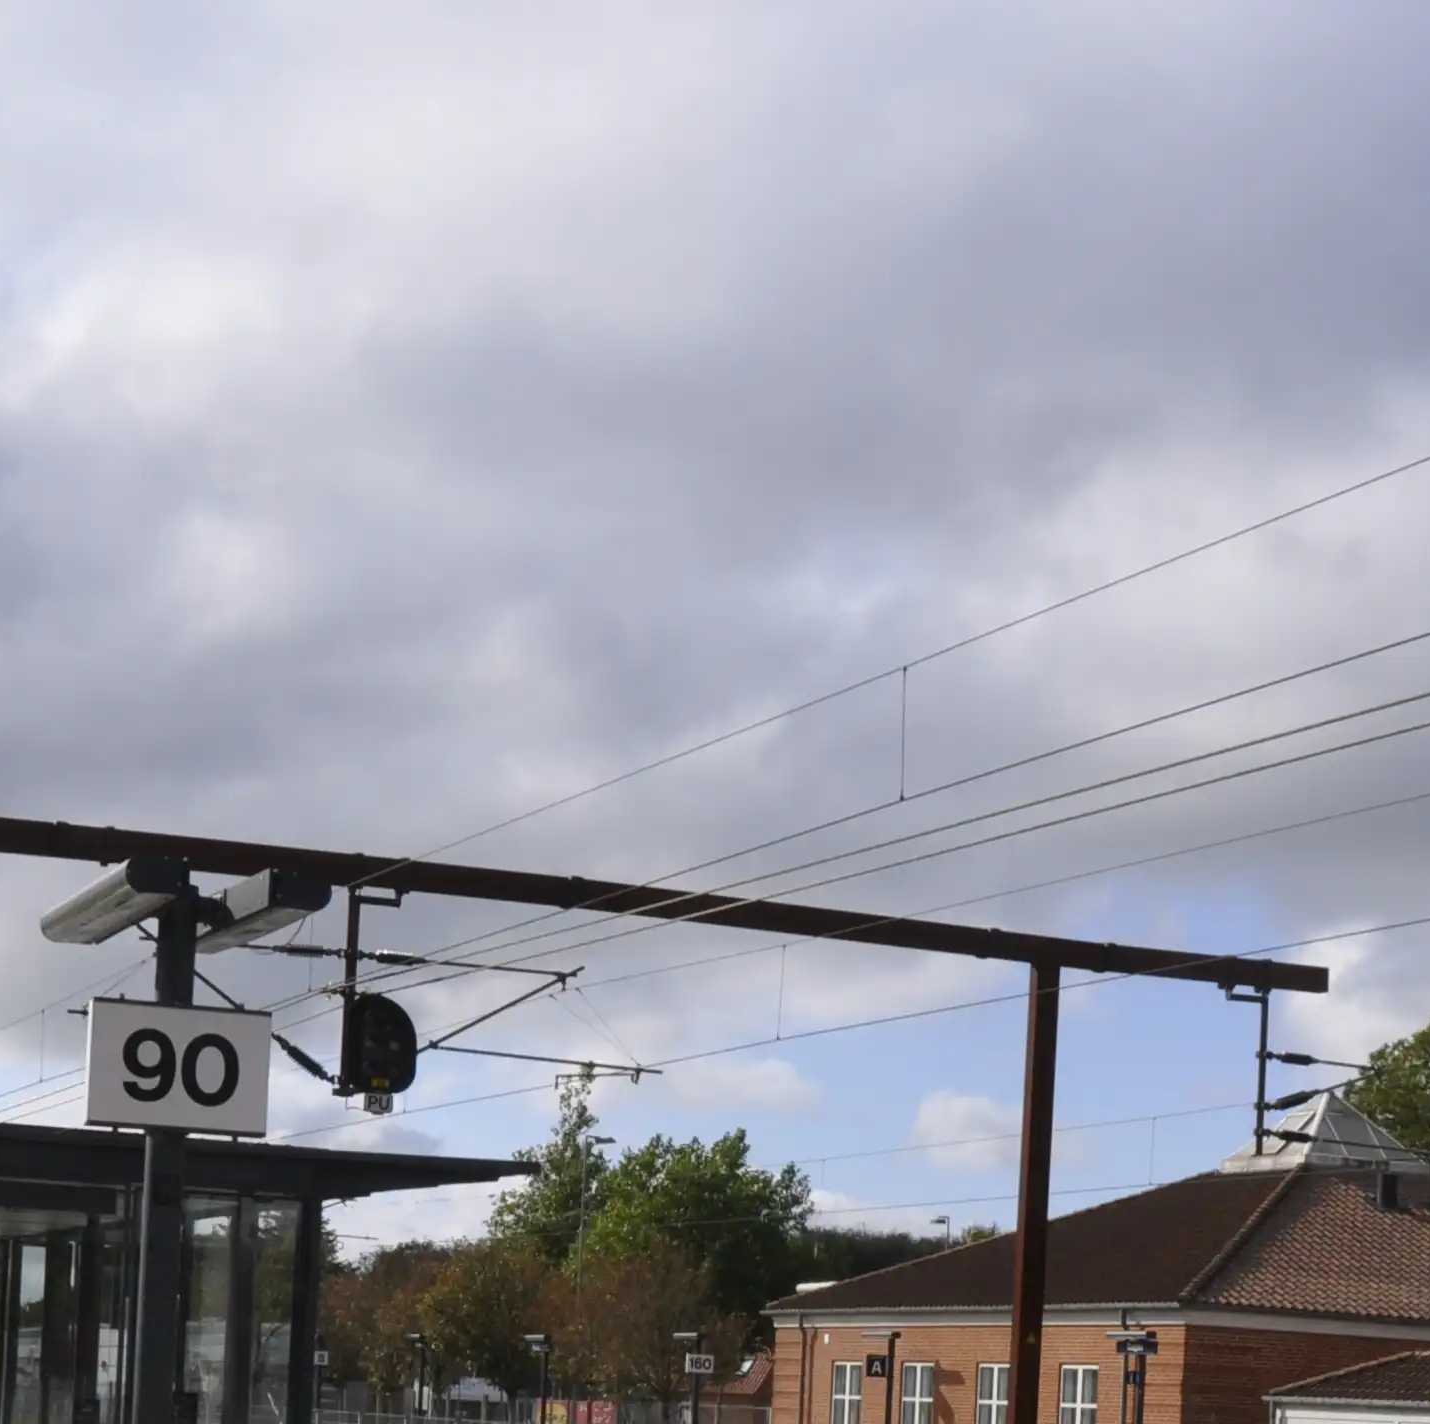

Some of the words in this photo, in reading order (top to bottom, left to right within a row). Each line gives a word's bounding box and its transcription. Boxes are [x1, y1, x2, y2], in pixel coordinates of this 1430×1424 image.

[121, 1027, 240, 1107] 90
[367, 1095, 391, 1110] PU
[689, 1356, 712, 1370] 160
[871, 1360, 882, 1375] A
